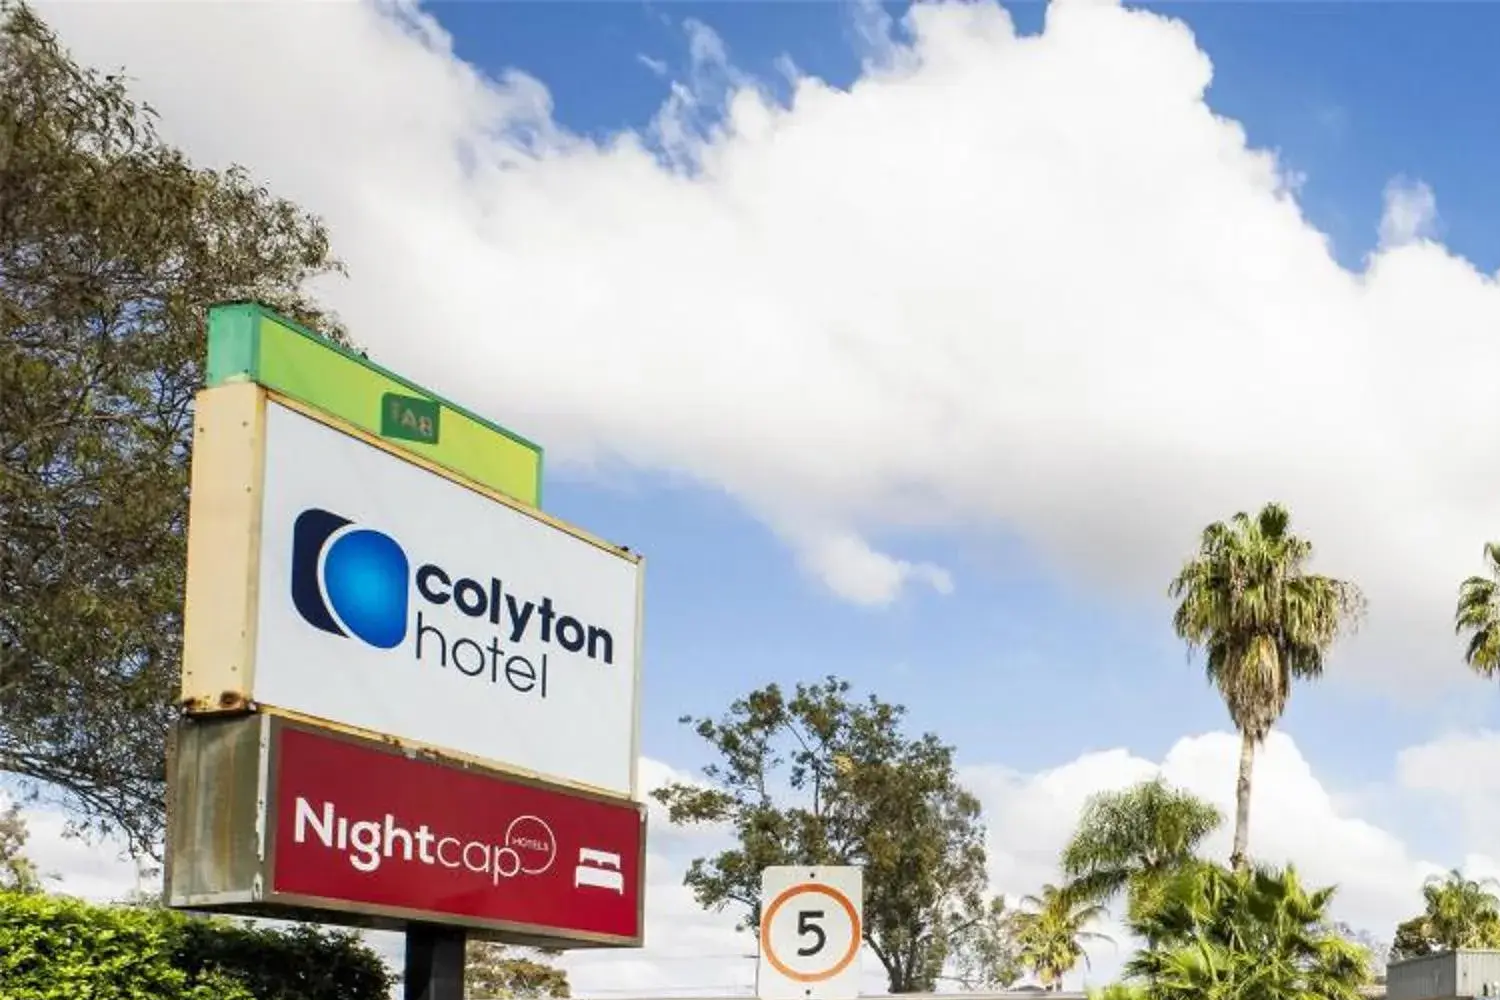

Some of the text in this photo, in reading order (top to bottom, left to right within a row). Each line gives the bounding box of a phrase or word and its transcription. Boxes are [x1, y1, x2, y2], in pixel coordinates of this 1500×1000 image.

[415, 563, 614, 665] colyton
[415, 610, 547, 699] hotel
[293, 796, 521, 887] Nightcap
[797, 909, 827, 957] 5
